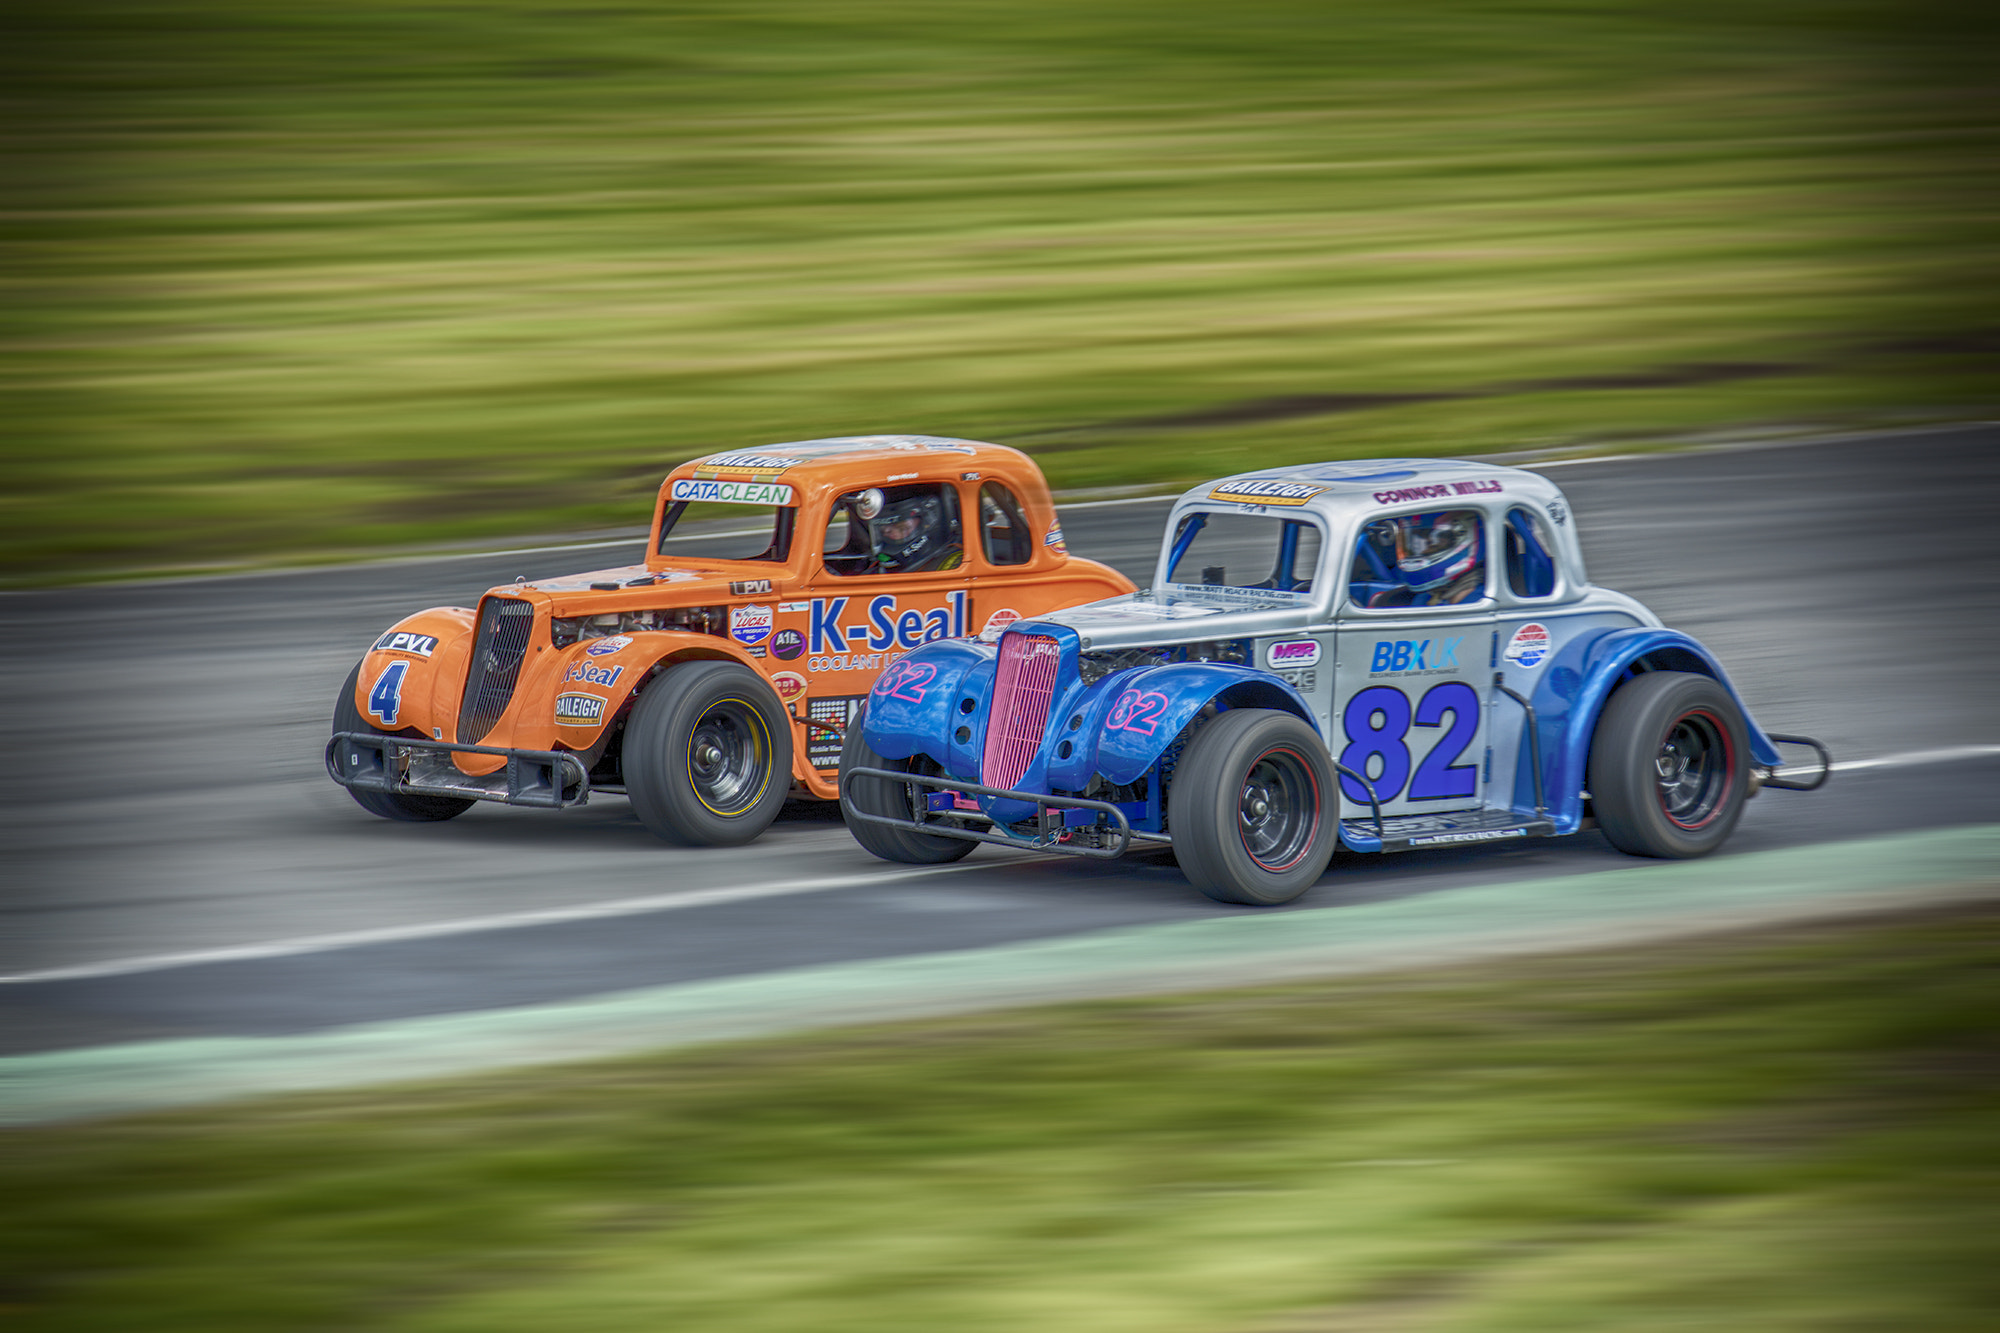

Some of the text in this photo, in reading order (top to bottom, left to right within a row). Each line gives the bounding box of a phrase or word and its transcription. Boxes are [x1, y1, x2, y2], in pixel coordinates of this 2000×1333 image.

[675, 481, 789, 503] CATACLEAN
[1217, 481, 1325, 498] BAILEIGH
[1373, 480, 1502, 504] CONNOR MILLS
[744, 579, 773, 594] PVL
[736, 616, 769, 627] LUCAS
[809, 590, 967, 654] K-Seal
[388, 632, 434, 658] PVL
[1273, 642, 1316, 660] MRR
[560, 660, 624, 688] K-Seal
[808, 654, 882, 672] COOLANT
[368, 660, 410, 725] 4
[874, 660, 937, 704] 82
[556, 697, 601, 718] BAILEIGH
[1106, 689, 1169, 737] 82
[1338, 680, 1480, 806] 82
